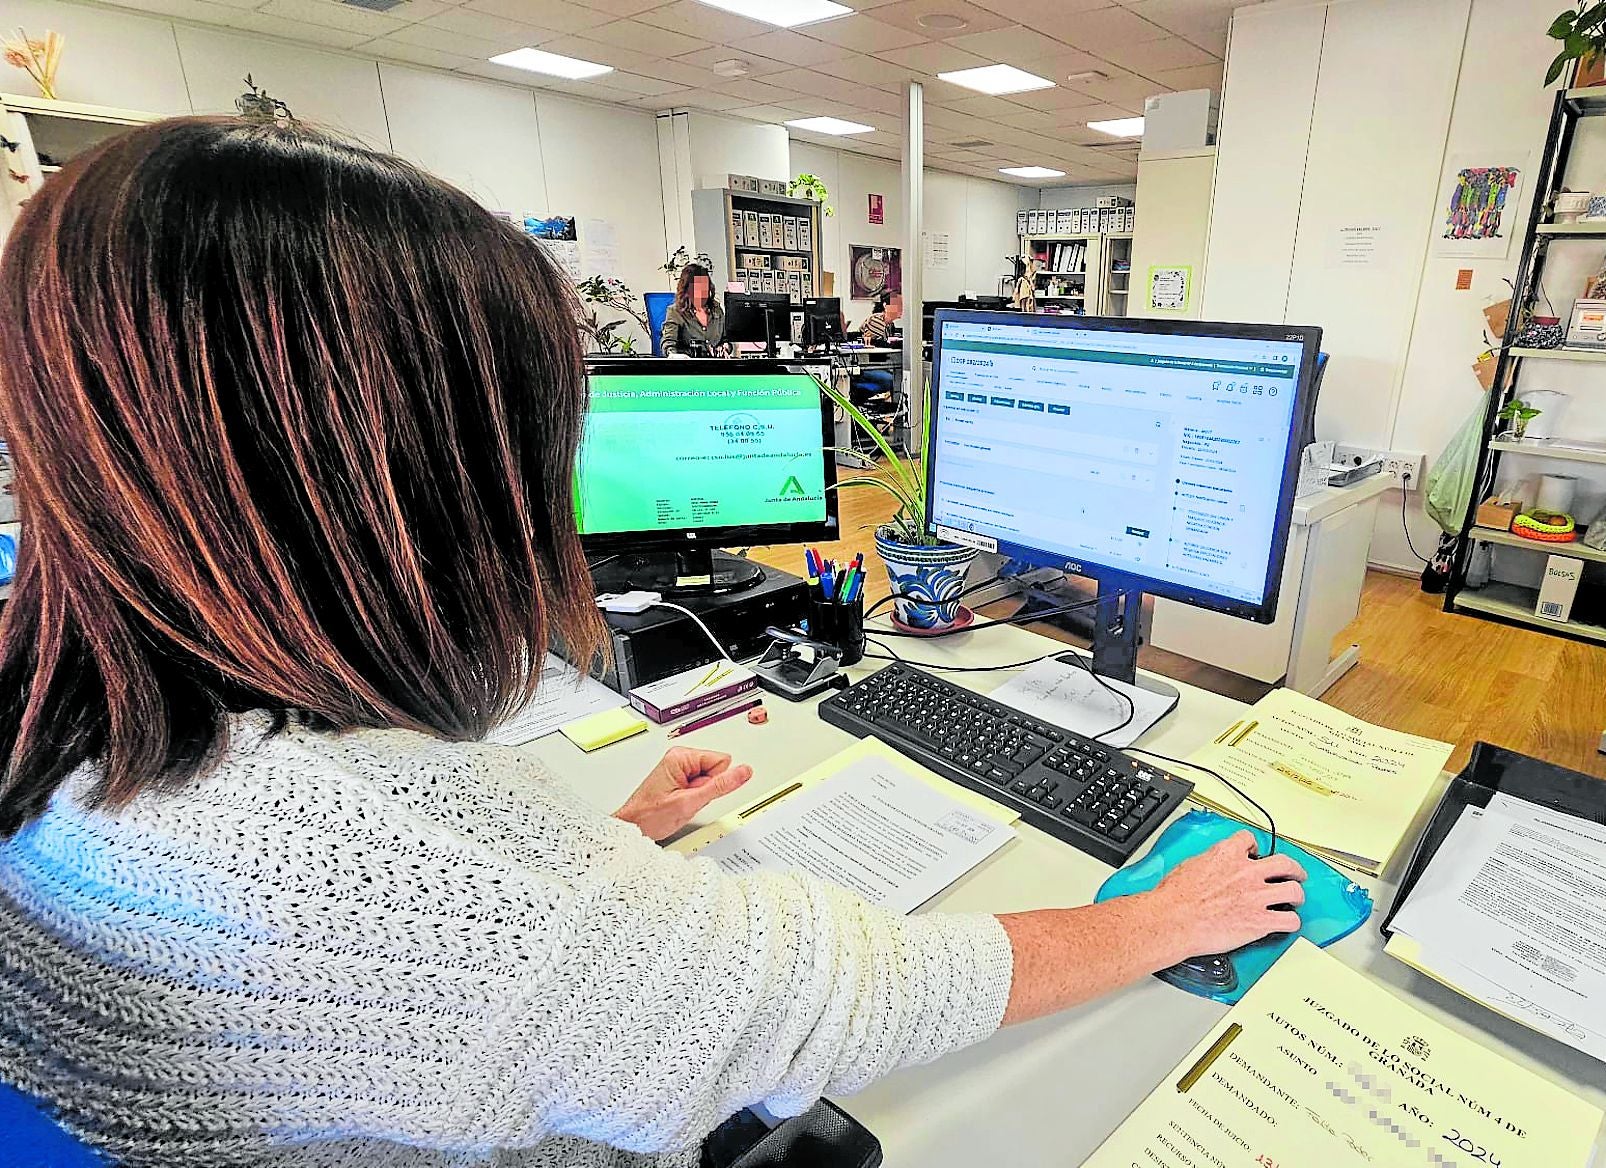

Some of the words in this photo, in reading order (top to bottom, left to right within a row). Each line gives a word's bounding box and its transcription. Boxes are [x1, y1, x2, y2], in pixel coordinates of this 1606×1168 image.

[603, 390, 639, 399] Justicia,
[640, 389, 705, 398] Administración
[707, 389, 728, 398] Local
[737, 389, 770, 398] Función
[772, 387, 801, 397] Pública
[1064, 561, 1082, 573] AOC
[1266, 1011, 1308, 1042] AUTOS
[1276, 1044, 1319, 1076] ASUNTO
[1303, 996, 1360, 1037] JUZGADO
[1363, 1036, 1381, 1051] DE
[1382, 1048, 1400, 1063] LO
[1402, 1062, 1454, 1098] SOCIAL
[1457, 1094, 1491, 1119] NÚM
[1494, 1116, 1502, 1125] 4
[1505, 1122, 1528, 1139] DE
[1368, 1050, 1434, 1095] GRANADA
[1211, 1071, 1279, 1128] DEMANDADO:
[1229, 1051, 1300, 1110] DEMANDANTE:
[1188, 1097, 1213, 1122] FECHA
[1212, 1117, 1226, 1131] DE
[1223, 1127, 1252, 1153] JUICIO:
[1398, 1101, 1434, 1128] AÑO:
[1156, 1133, 1192, 1166] RECURSO
[1168, 1120, 1210, 1159] SENTENCIA
[1441, 1128, 1501, 1168] 2024
